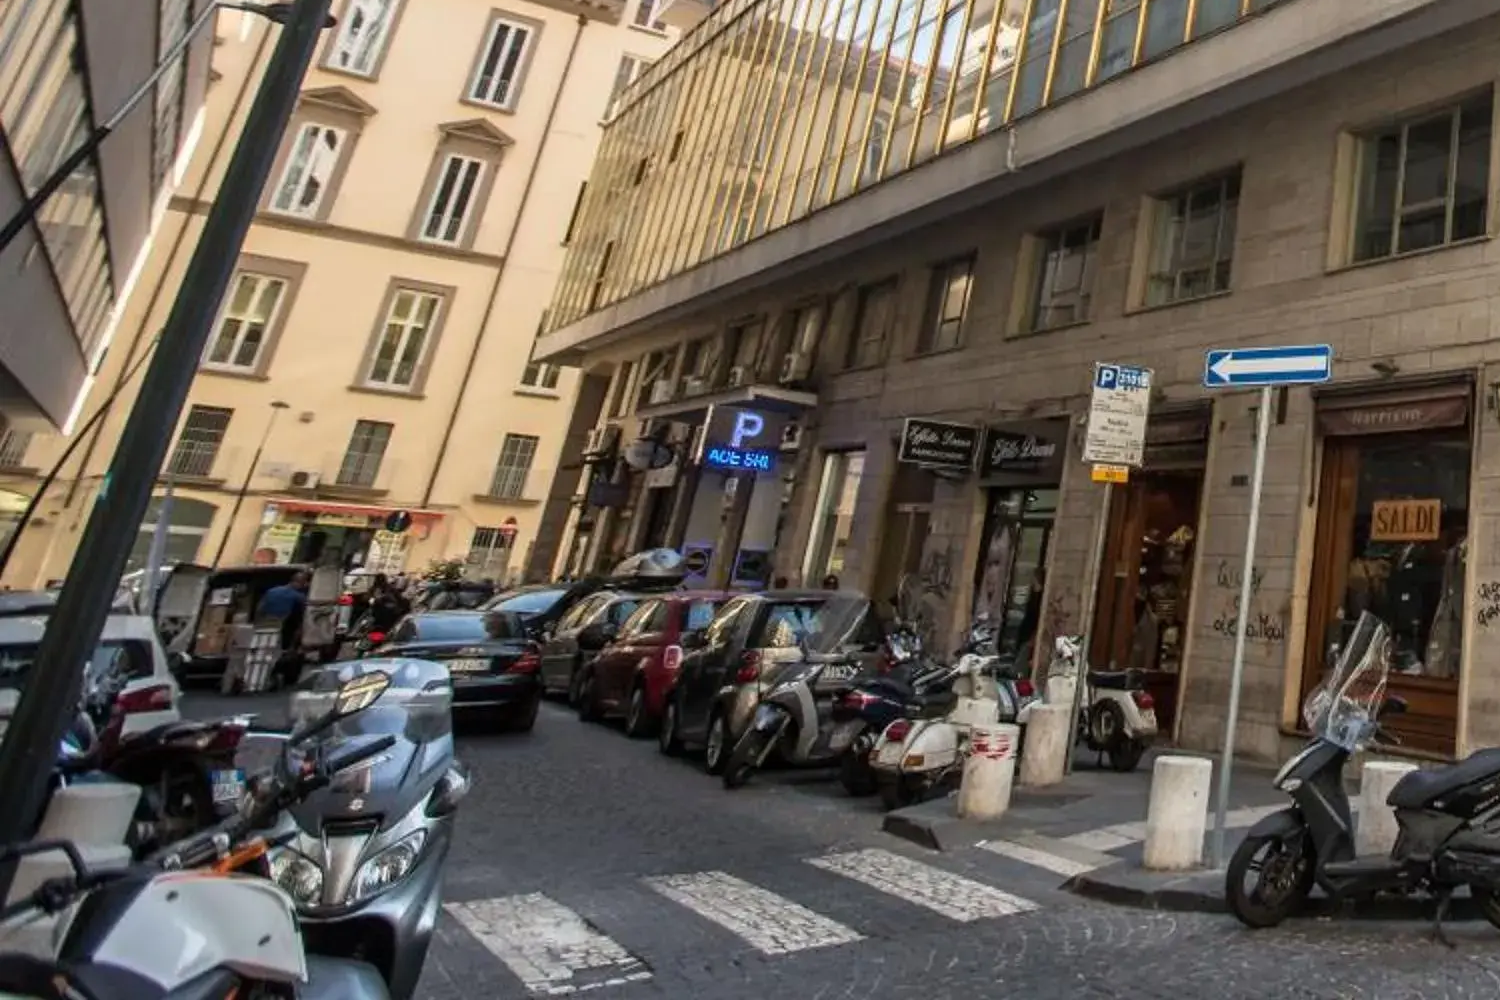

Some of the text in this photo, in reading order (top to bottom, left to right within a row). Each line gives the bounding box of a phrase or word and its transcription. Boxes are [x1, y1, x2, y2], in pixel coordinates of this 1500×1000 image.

[1101, 369, 1115, 387] P
[731, 411, 764, 448] P
[1376, 504, 1435, 535] SALDI
